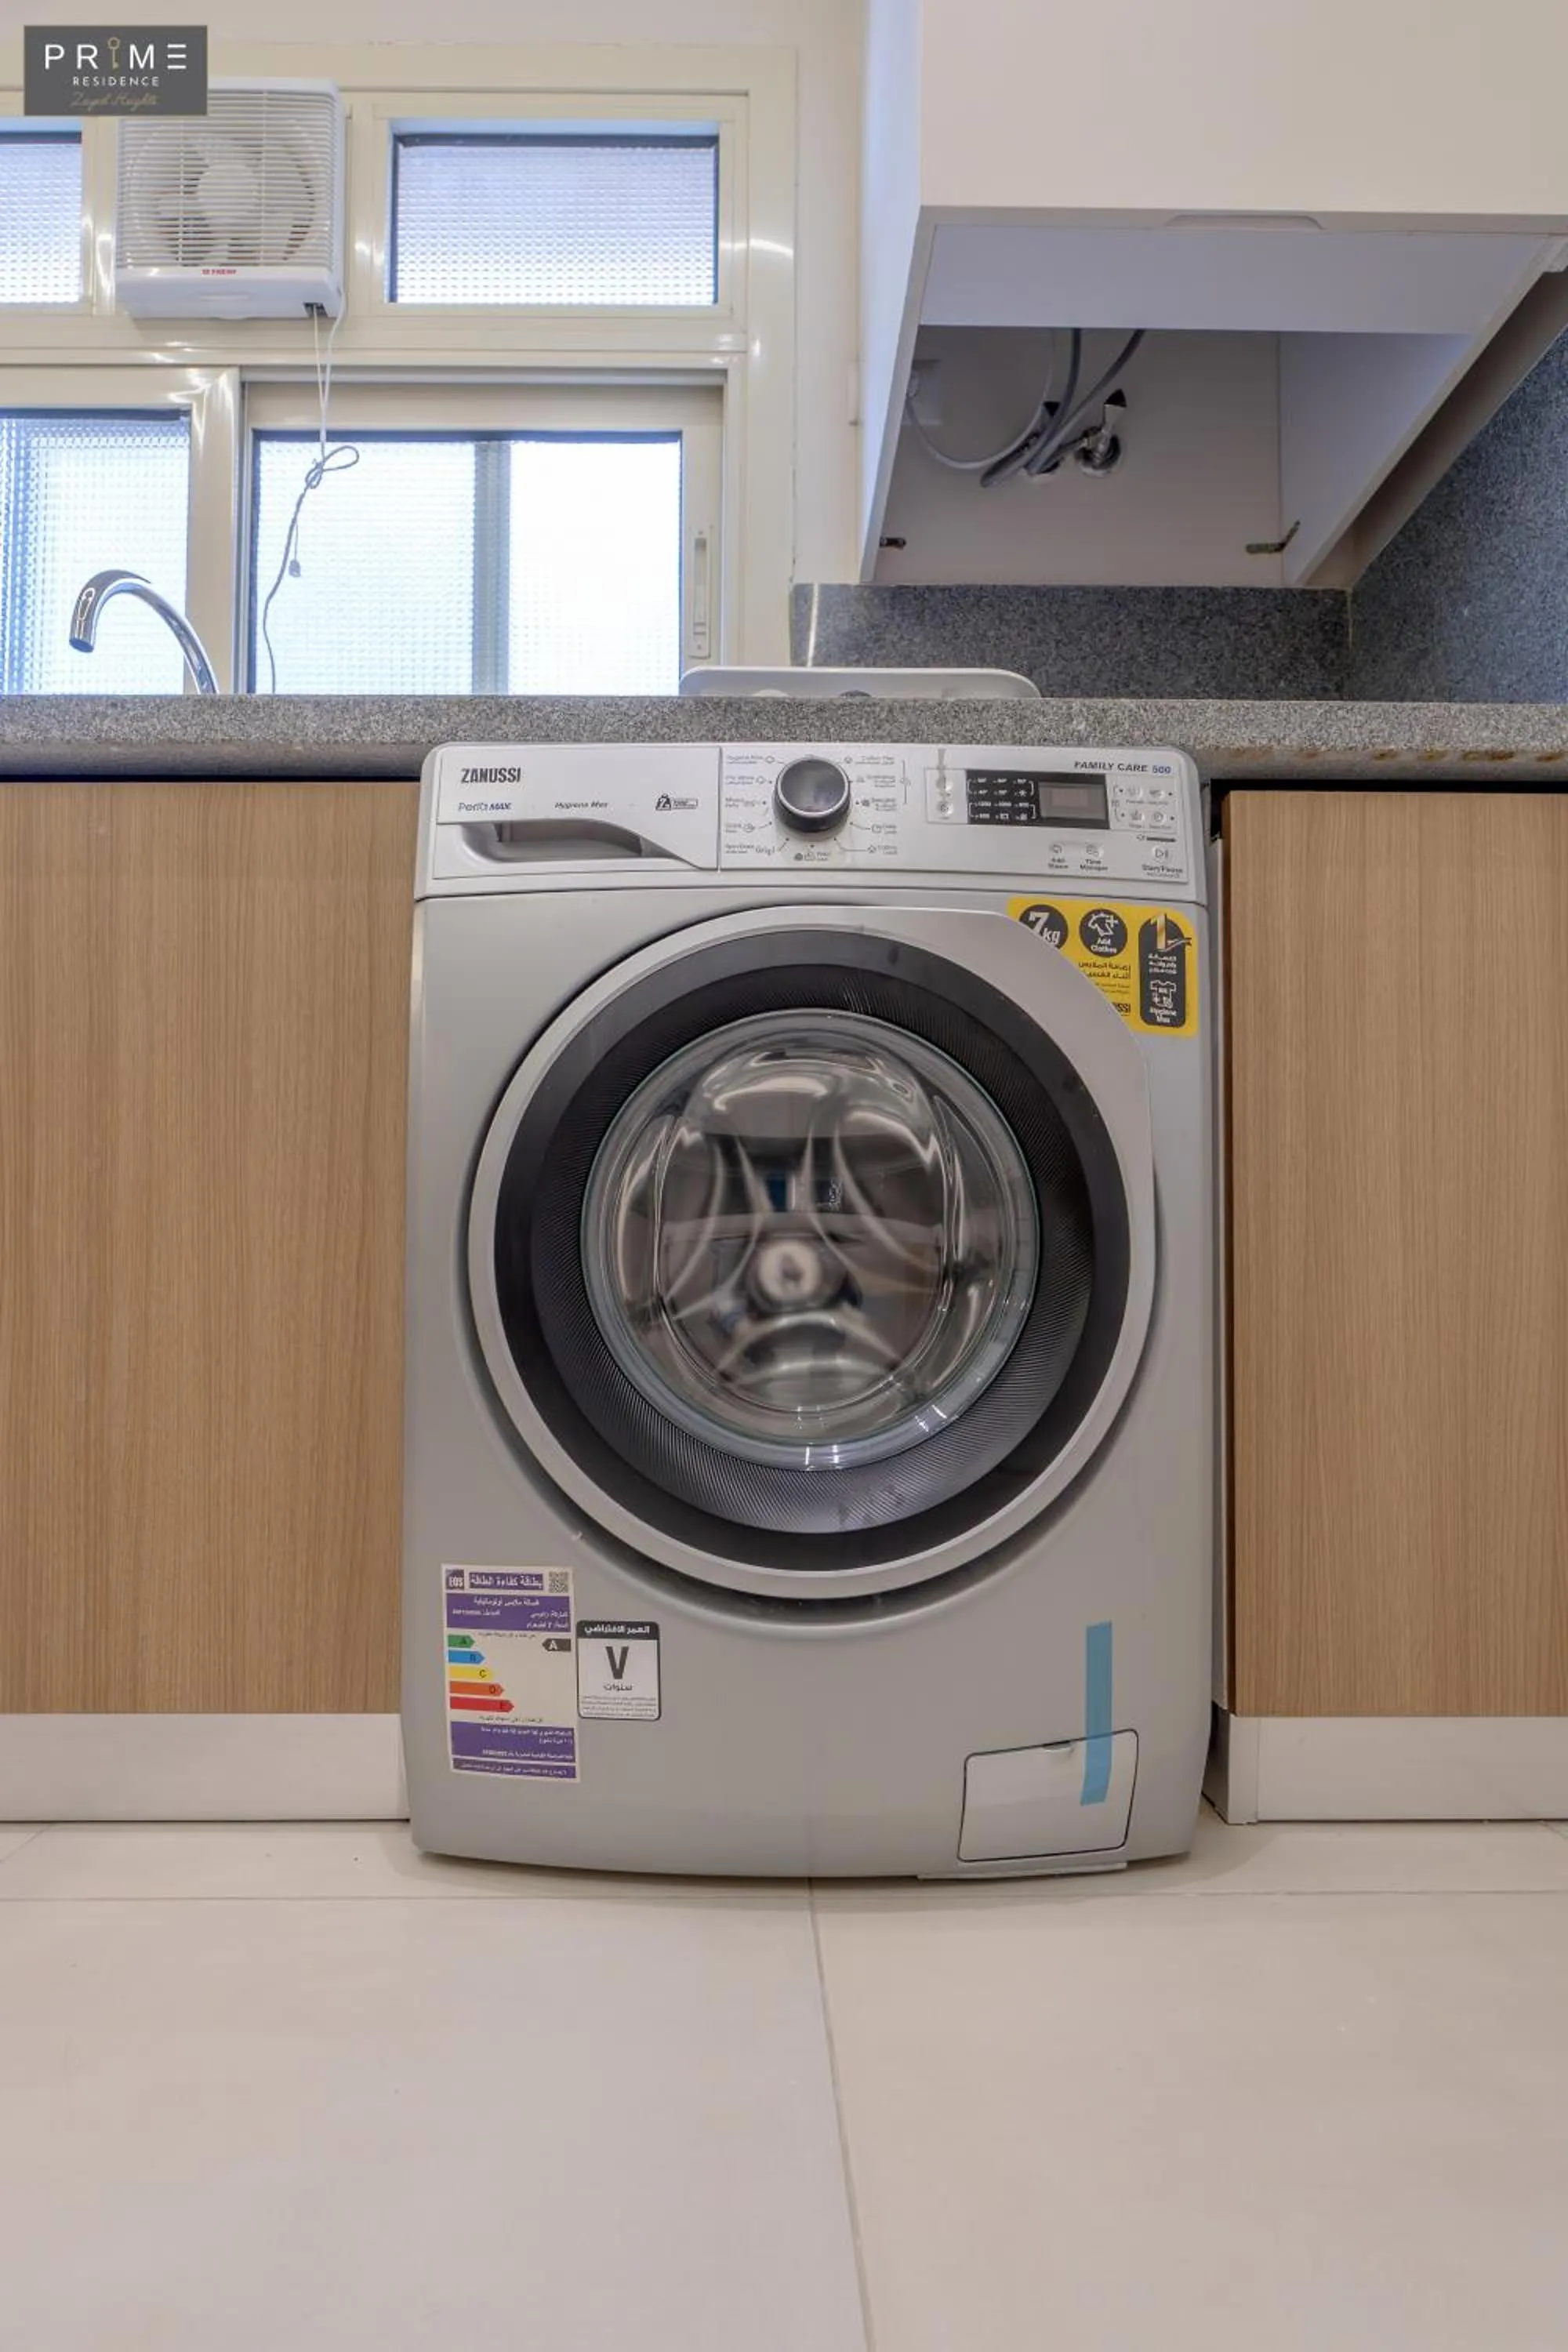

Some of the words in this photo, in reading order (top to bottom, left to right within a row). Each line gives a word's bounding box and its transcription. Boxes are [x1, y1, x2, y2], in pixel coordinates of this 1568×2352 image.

[1074, 760, 1114, 771] FAMILY
[1117, 763, 1149, 772] CARE
[1152, 764, 1172, 774] 500
[460, 767, 521, 784] ZANUSSI
[1028, 910, 1050, 935] 7
[1043, 927, 1061, 945] kg
[495, 1574, 517, 1588] كفاءة
[520, 1573, 543, 1589] بطاقة
[549, 1639, 558, 1650] A
[479, 1669, 487, 1678] C
